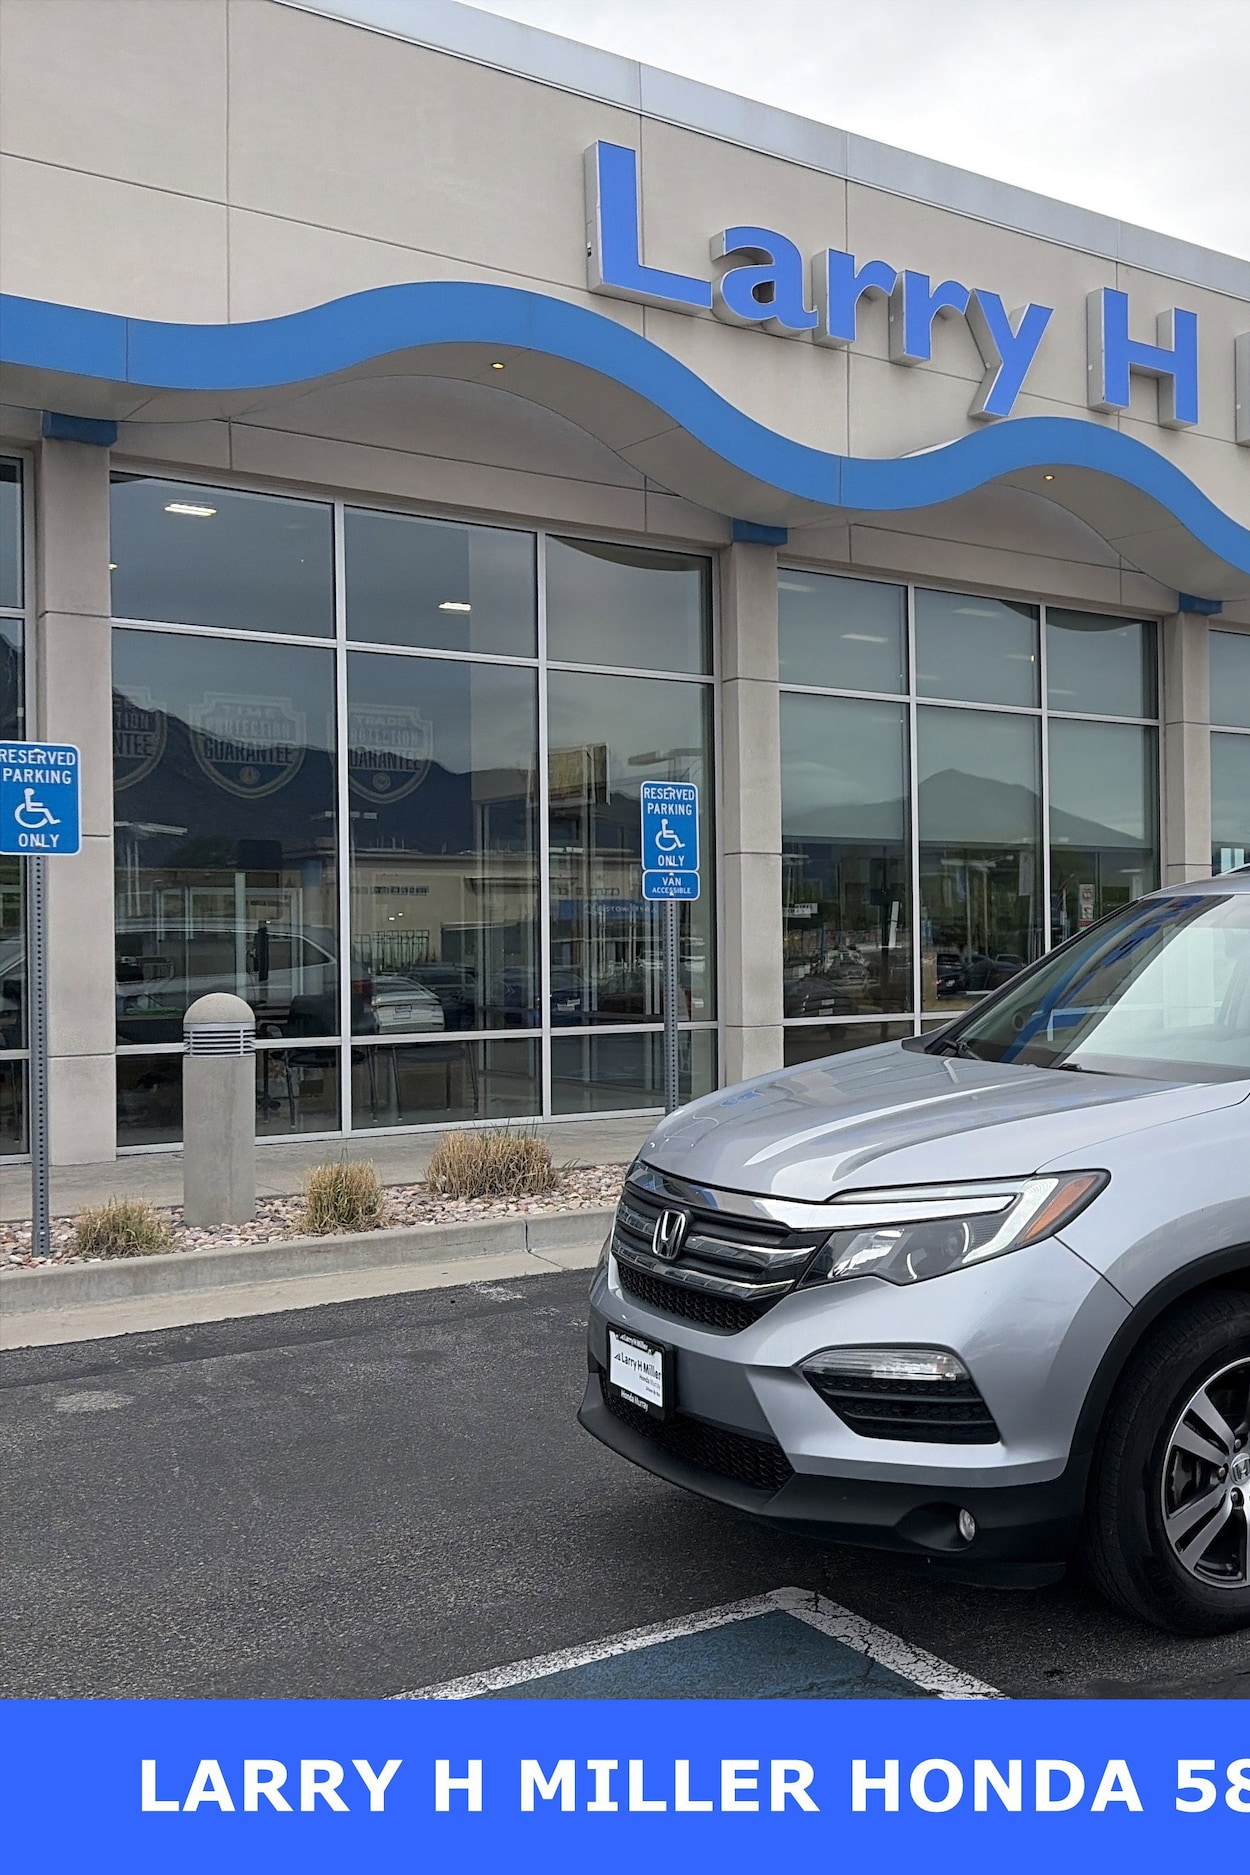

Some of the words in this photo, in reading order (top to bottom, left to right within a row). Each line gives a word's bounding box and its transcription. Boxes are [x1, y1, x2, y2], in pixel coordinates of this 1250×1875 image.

[586, 140, 1053, 421] Larry
[1087, 287, 1197, 429] H
[350, 727, 418, 746] ROTECTION
[0, 748, 76, 766] RESERVED
[204, 735, 293, 764] GUARANTEE
[349, 747, 421, 770] UARANTEE
[3, 767, 72, 785] PARKING
[643, 787, 695, 801] RESERVED
[647, 802, 693, 816] PARKING
[18, 832, 60, 848] ONLY
[657, 854, 685, 867] ONLY
[651, 886, 692, 895] ACCESSIBLE
[662, 876, 682, 887] VAN
[621, 1351, 638, 1371] Larry
[638, 1359, 643, 1372] H
[643, 1361, 661, 1381] Miller
